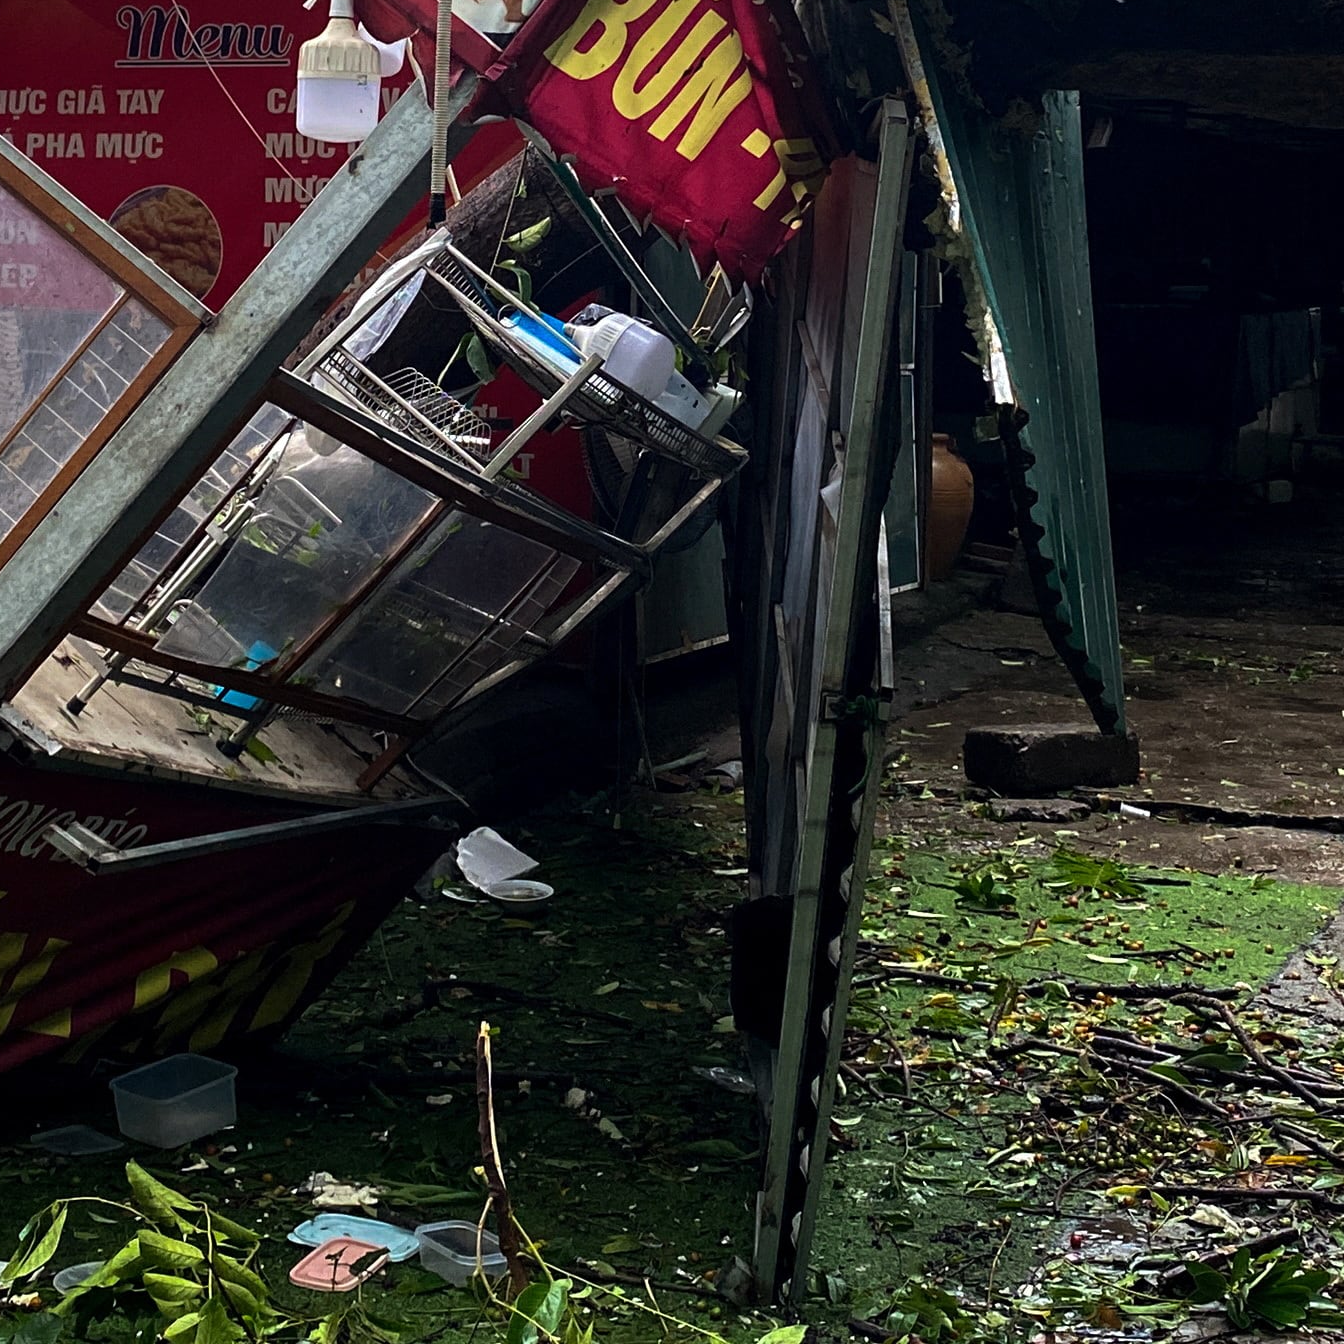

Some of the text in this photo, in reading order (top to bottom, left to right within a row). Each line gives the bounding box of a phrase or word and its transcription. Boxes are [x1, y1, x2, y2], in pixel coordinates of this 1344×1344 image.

[116, 3, 294, 61] Menu
[57, 84, 106, 116] GIÃ
[117, 88, 166, 116] TAY
[26, 132, 85, 159] PHA
[95, 130, 165, 165] MỰC
